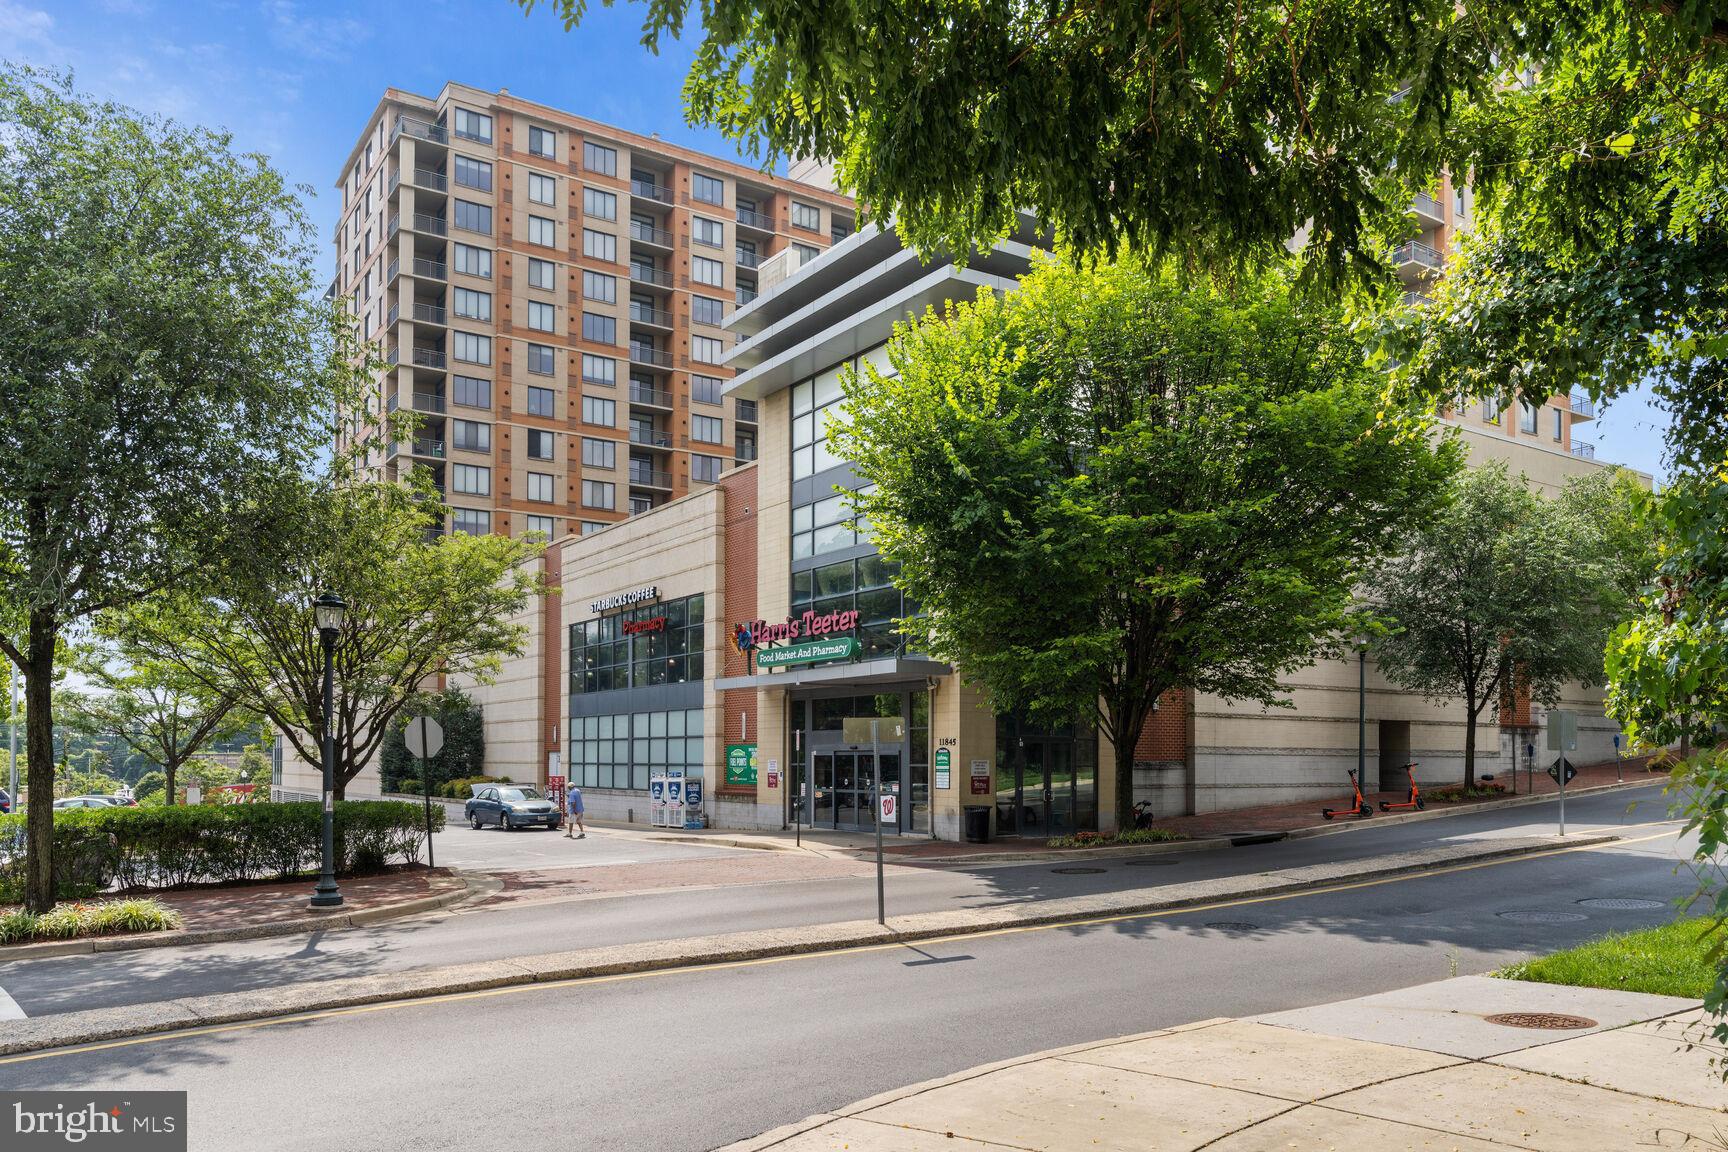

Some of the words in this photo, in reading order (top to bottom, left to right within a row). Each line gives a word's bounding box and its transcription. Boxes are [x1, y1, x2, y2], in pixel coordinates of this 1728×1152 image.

[591, 594, 627, 613] STARBUCKS
[628, 586, 657, 604] COFFEE
[623, 616, 665, 635] Pharmacy
[751, 616, 799, 644] Harris
[802, 609, 859, 637] Teeter
[759, 653, 774, 663] Food
[775, 650, 797, 661] Market
[797, 648, 812, 658] And
[812, 643, 848, 657] Pharmacy
[939, 738, 957, 746] 11845
